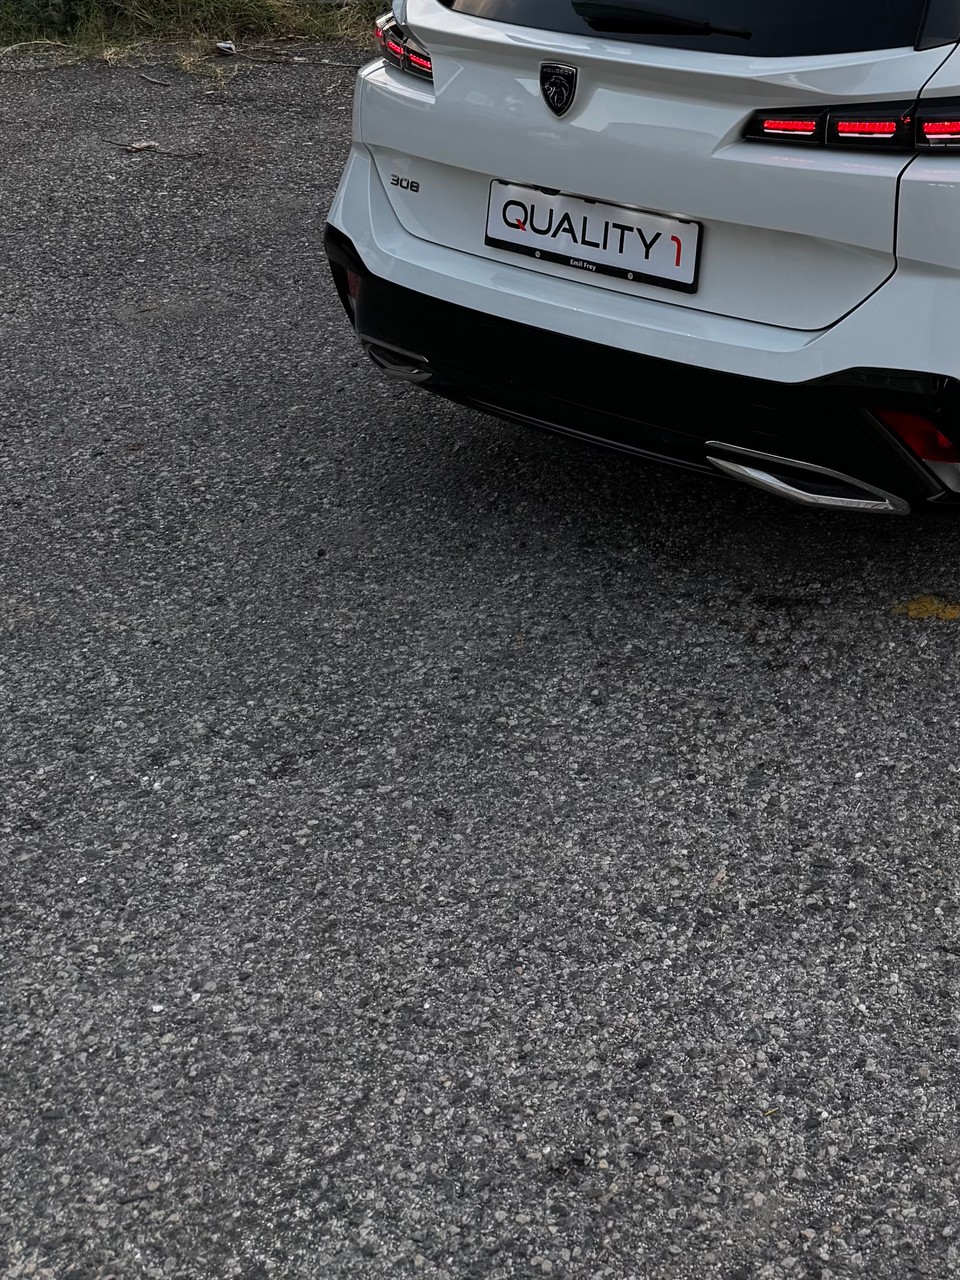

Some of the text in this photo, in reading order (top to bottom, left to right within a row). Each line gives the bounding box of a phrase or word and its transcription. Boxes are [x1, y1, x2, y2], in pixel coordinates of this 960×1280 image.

[390, 174, 420, 193] 308
[502, 200, 683, 267] QUALITY 1
[570, 259, 597, 272] Emil Frey
